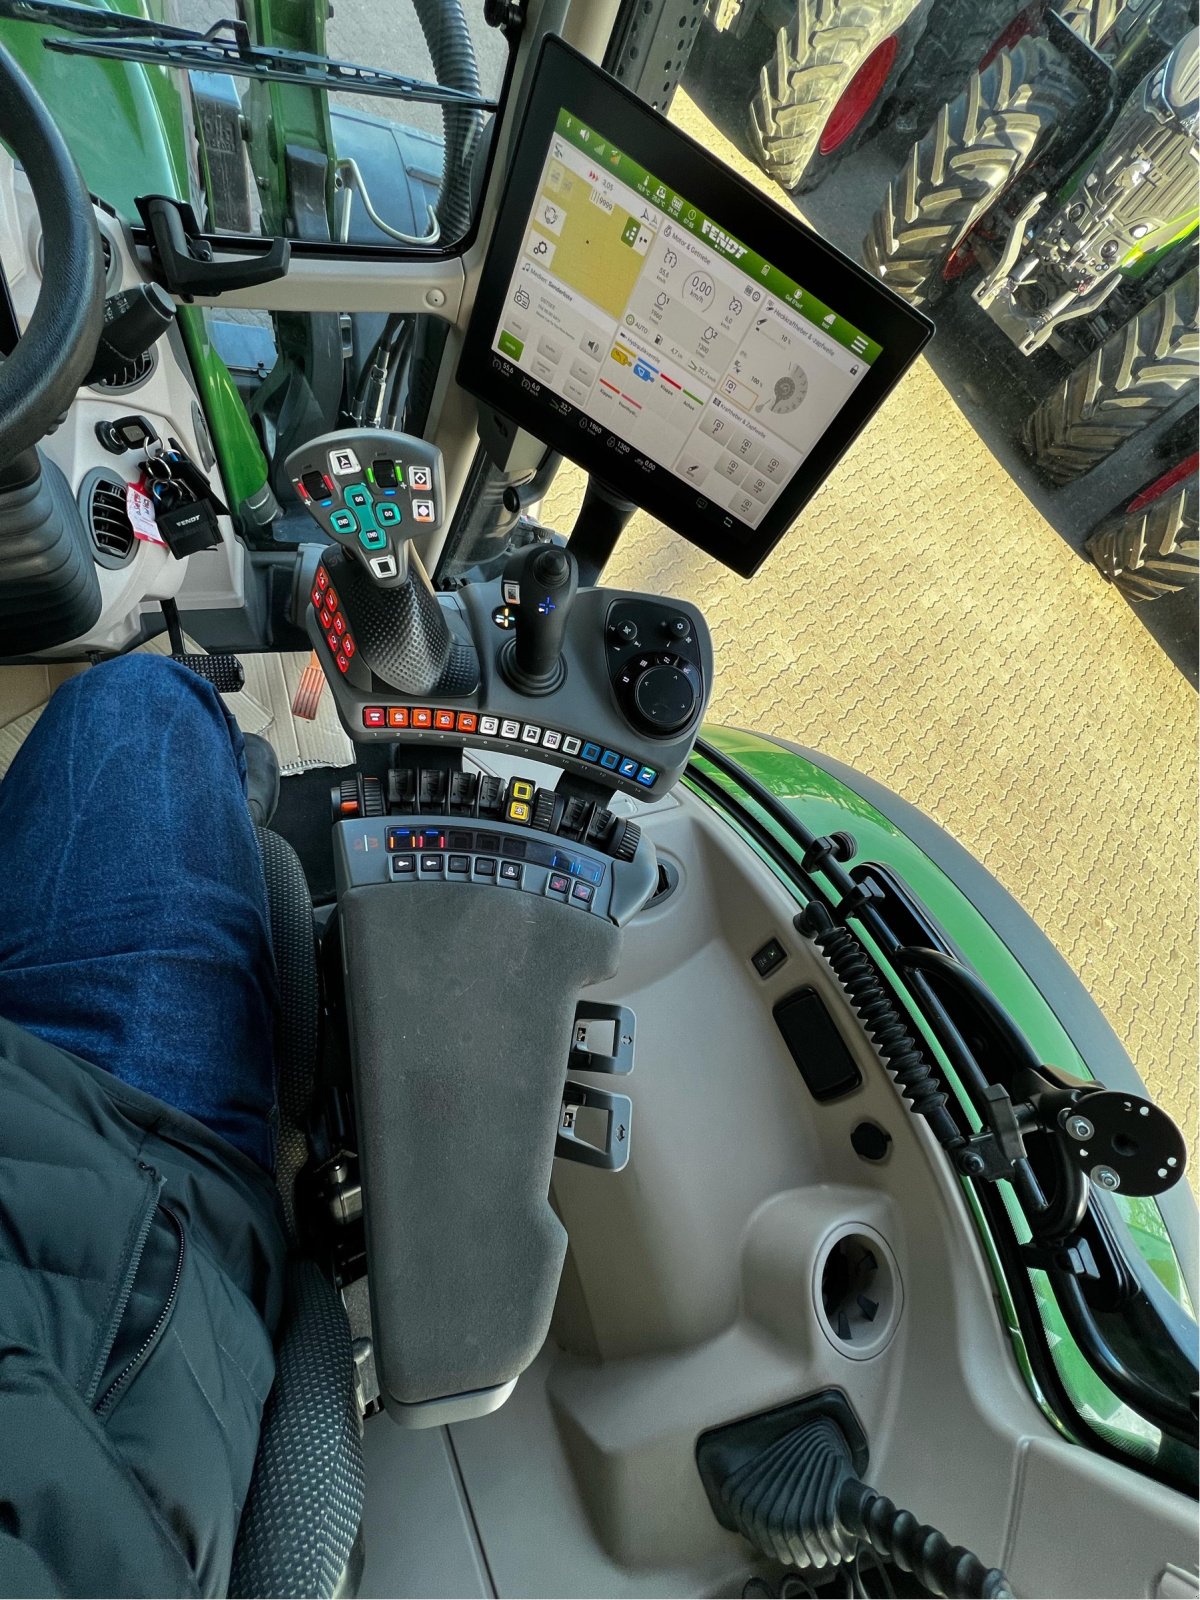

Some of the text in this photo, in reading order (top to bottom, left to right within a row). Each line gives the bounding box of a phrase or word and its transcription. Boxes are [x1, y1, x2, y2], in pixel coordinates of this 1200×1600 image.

[598, 196, 613, 212] 9999
[701, 219, 748, 260] FENDT
[671, 232, 686, 247] Motor
[689, 245, 711, 265] Getriebe
[690, 275, 712, 298] 0,00
[689, 289, 704, 304] km/h
[634, 321, 648, 334] AUTO
[772, 308, 809, 337] Heckkraftheber
[626, 336, 661, 364] Hydraulikventile
[502, 361, 514, 374] 55,6
[588, 421, 602, 434] 1960
[719, 403, 742, 422] Kraftheber
[744, 421, 766, 439] Zapfwelle
[616, 440, 630, 453] 1300
[643, 459, 656, 471] 0,00
